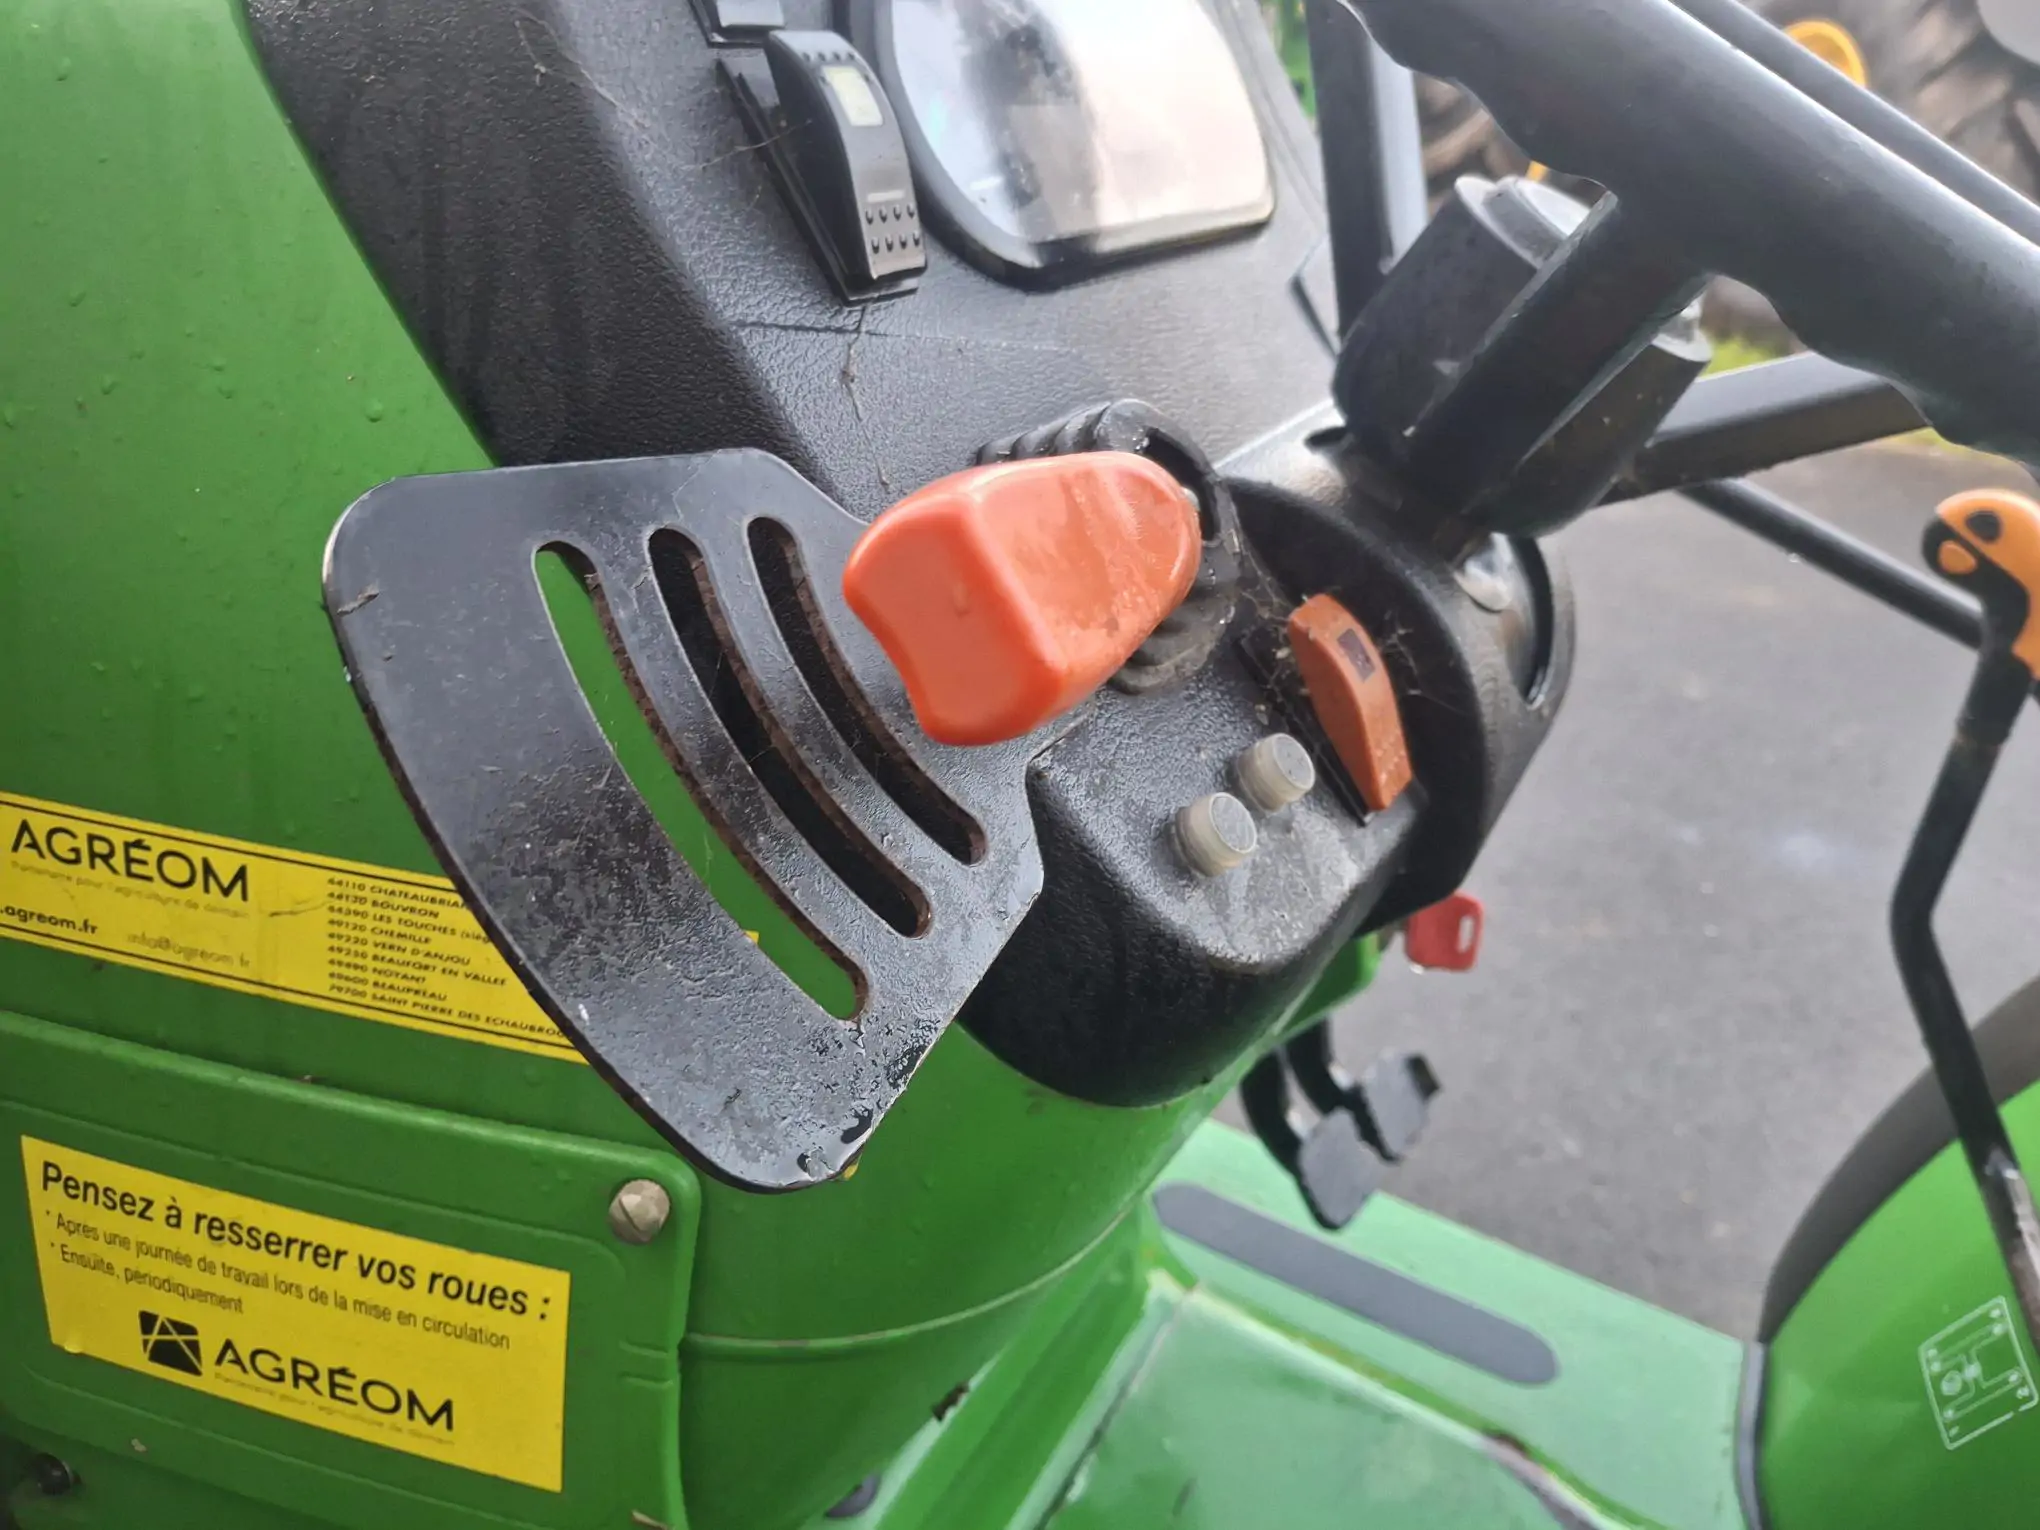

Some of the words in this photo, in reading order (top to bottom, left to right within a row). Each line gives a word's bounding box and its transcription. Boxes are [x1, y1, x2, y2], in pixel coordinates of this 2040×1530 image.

[11, 819, 248, 902] AGRÉOM
[327, 877, 366, 892] 44110
[371, 899, 440, 919] BOUVRON
[370, 925, 431, 945] CHEMILLE
[373, 912, 393, 925] LES
[398, 917, 457, 937] TOUCHES
[373, 940, 407, 954] VERN
[411, 948, 471, 966] D'ANJOU
[372, 954, 436, 973] BEAUFORT
[441, 965, 459, 978] EN
[464, 971, 507, 986] VALLEE
[372, 967, 426, 984] NOYANT
[372, 993, 409, 1008] SAINT
[412, 1001, 453, 1017] PIERRE
[458, 1010, 481, 1022] DES
[42, 1160, 155, 1222] Pensez
[165, 1195, 183, 1230] à
[194, 1212, 348, 1272] resserrer
[358, 1253, 416, 1290] vos
[428, 1271, 529, 1315] roues
[103, 1227, 131, 1251] une
[135, 1240, 193, 1270] journée
[197, 1254, 216, 1276] de
[221, 1261, 269, 1290] travail
[273, 1274, 304, 1301] lors
[308, 1285, 329, 1306] de
[334, 1289, 348, 1311] la
[353, 1298, 393, 1322] mise
[397, 1309, 417, 1328] en
[422, 1314, 511, 1350] circulation
[214, 1338, 454, 1432] AGRÉOM
